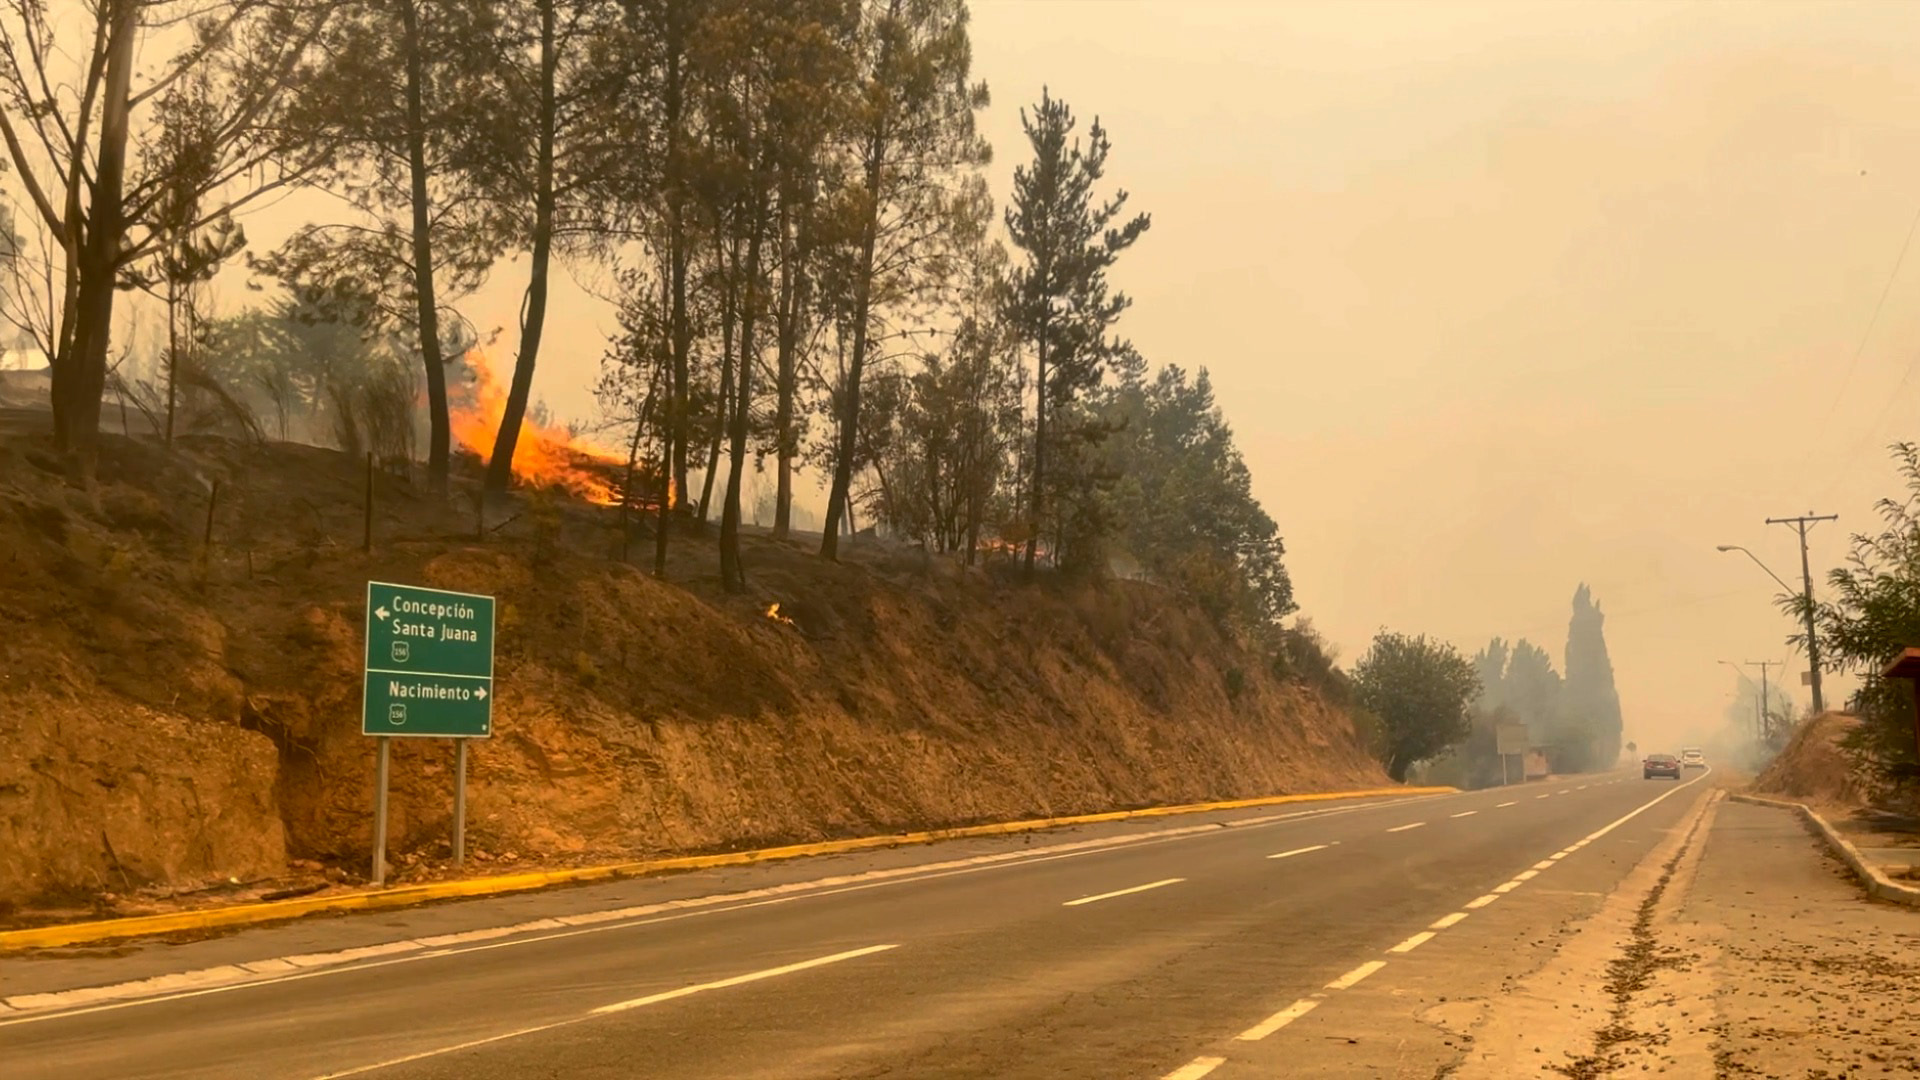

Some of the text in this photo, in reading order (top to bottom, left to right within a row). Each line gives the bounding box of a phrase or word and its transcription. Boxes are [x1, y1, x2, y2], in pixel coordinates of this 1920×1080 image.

[393, 596, 474, 620] Concepción
[392, 619, 477, 642] Santa Juana
[394, 647, 406, 656] 156
[389, 681, 470, 700] Nacimiento
[391, 710, 403, 719] 156
